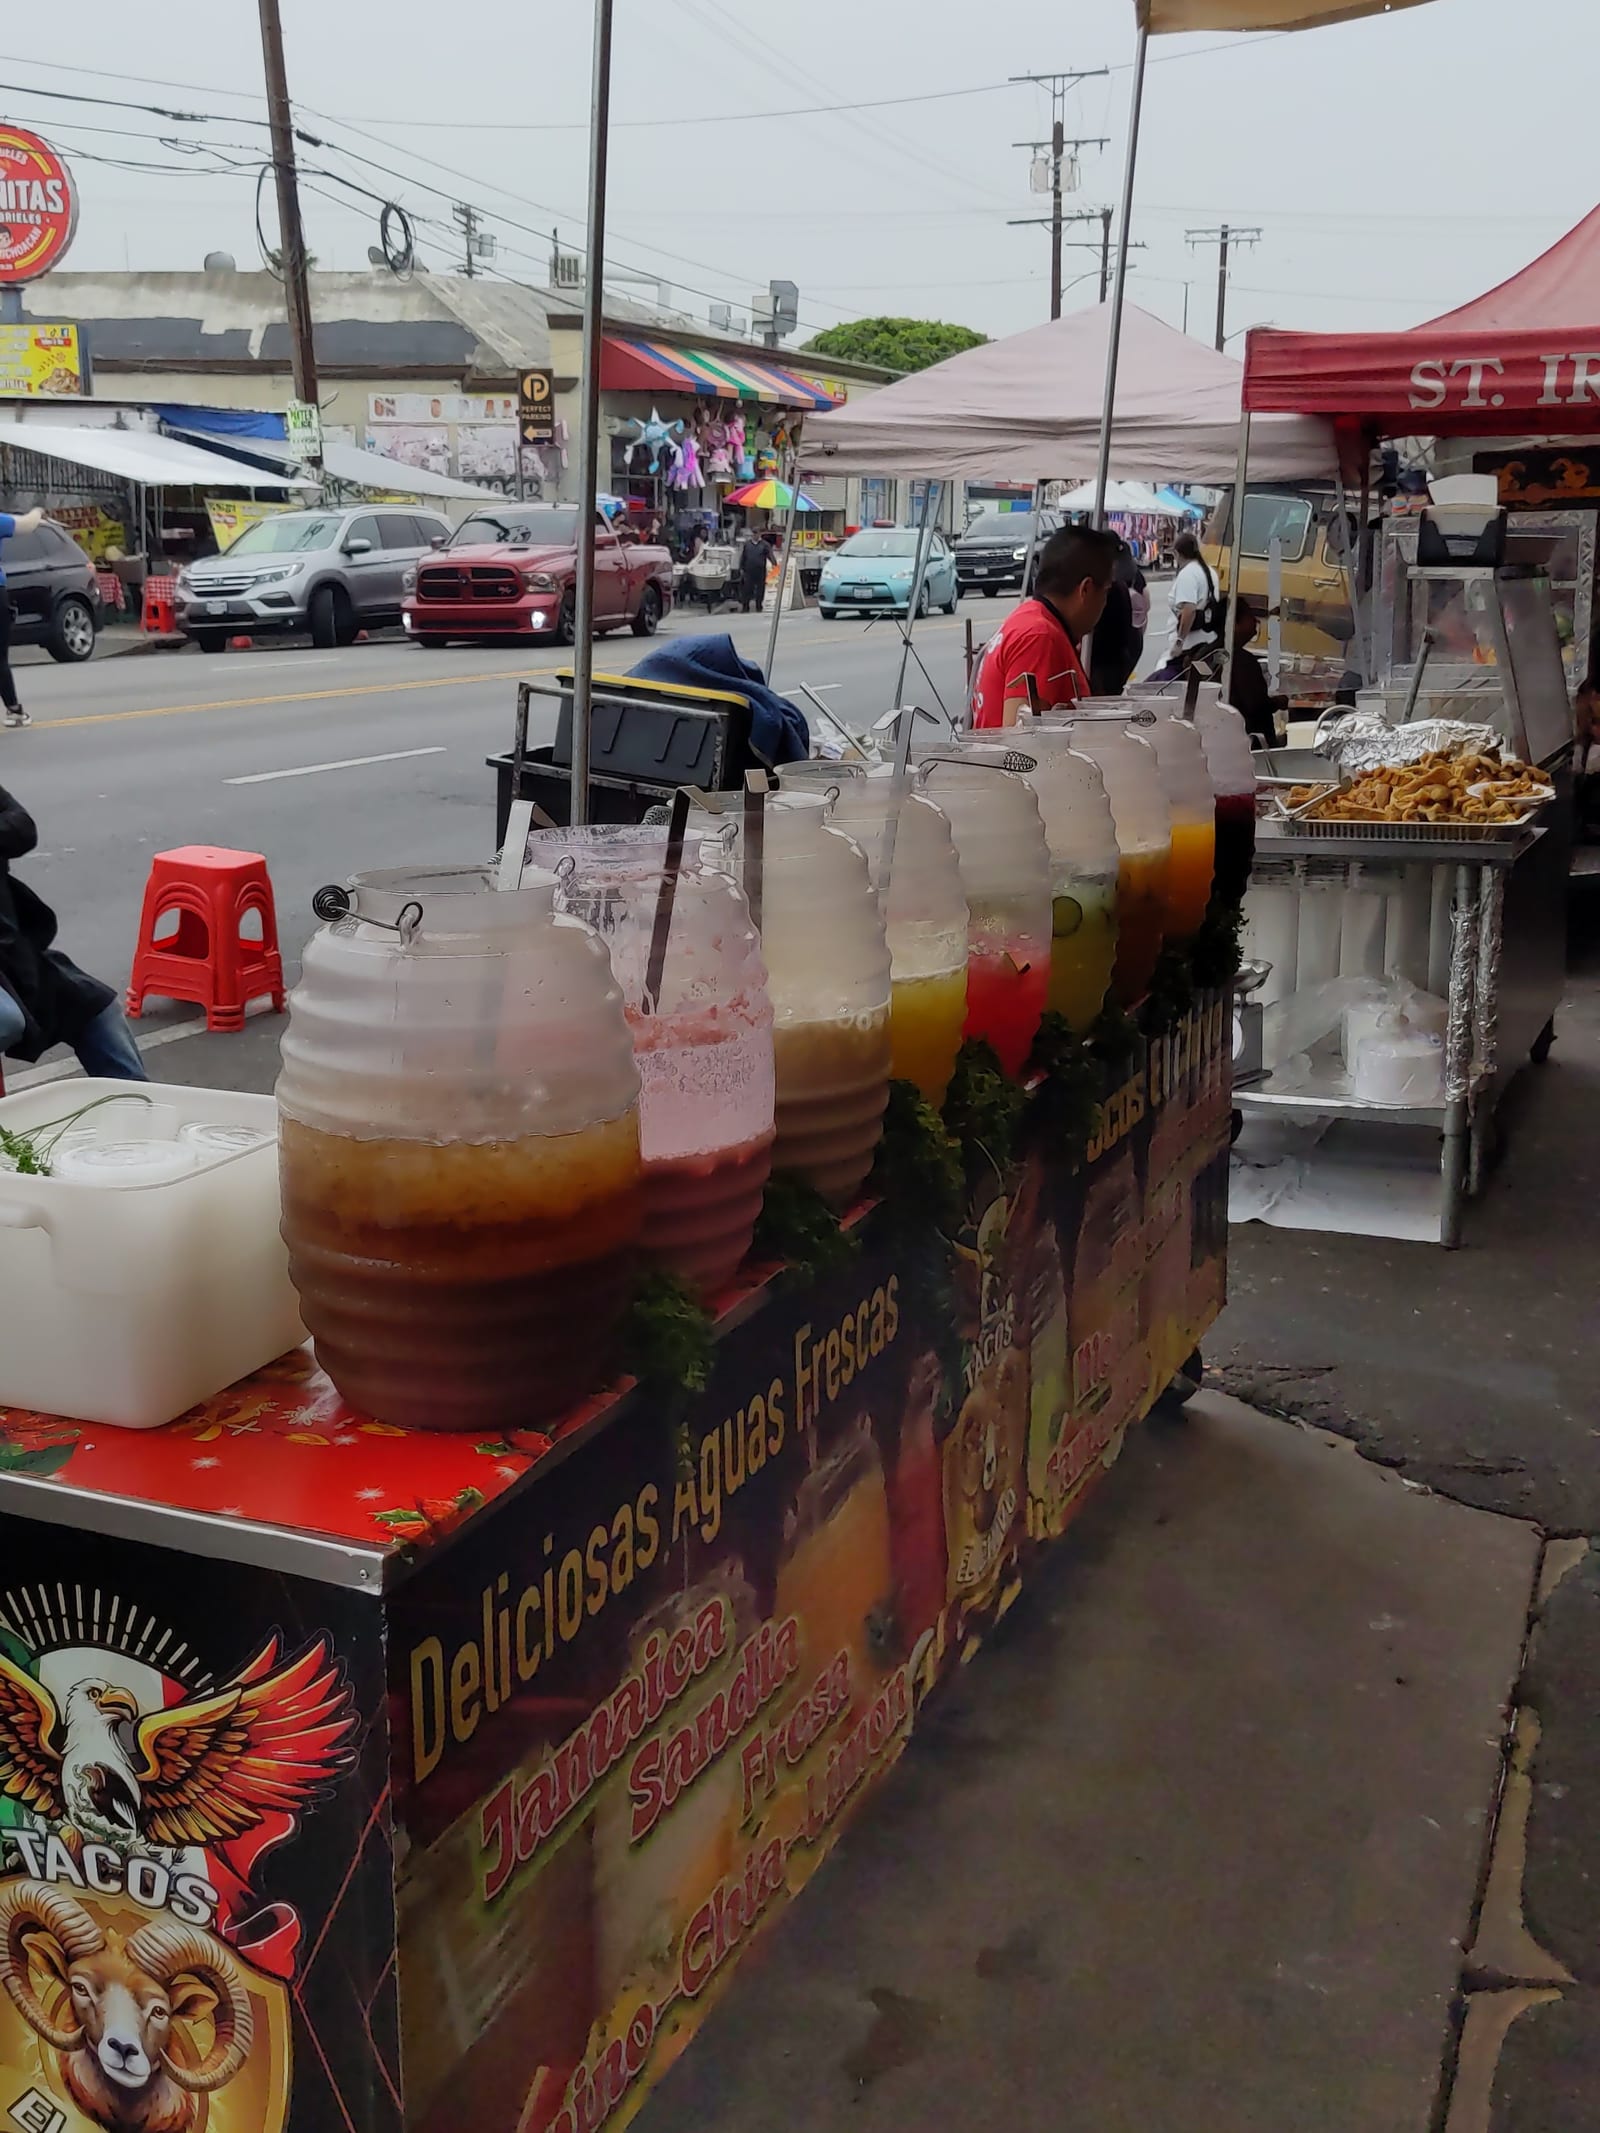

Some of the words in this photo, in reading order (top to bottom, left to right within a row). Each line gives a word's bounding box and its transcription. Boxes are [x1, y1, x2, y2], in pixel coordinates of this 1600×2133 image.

[521, 405, 551, 413] PERFECT
[1408, 357, 1505, 409] ST.
[962, 1317, 1013, 1389] TACOS
[410, 1481, 661, 1785] Deliciosas
[671, 1376, 784, 1543] Aguas
[795, 1273, 900, 1431] Frescas
[481, 1598, 728, 1903] Jamaica
[628, 1615, 801, 1844] Sandia
[1, 1826, 220, 1927] TACOS
